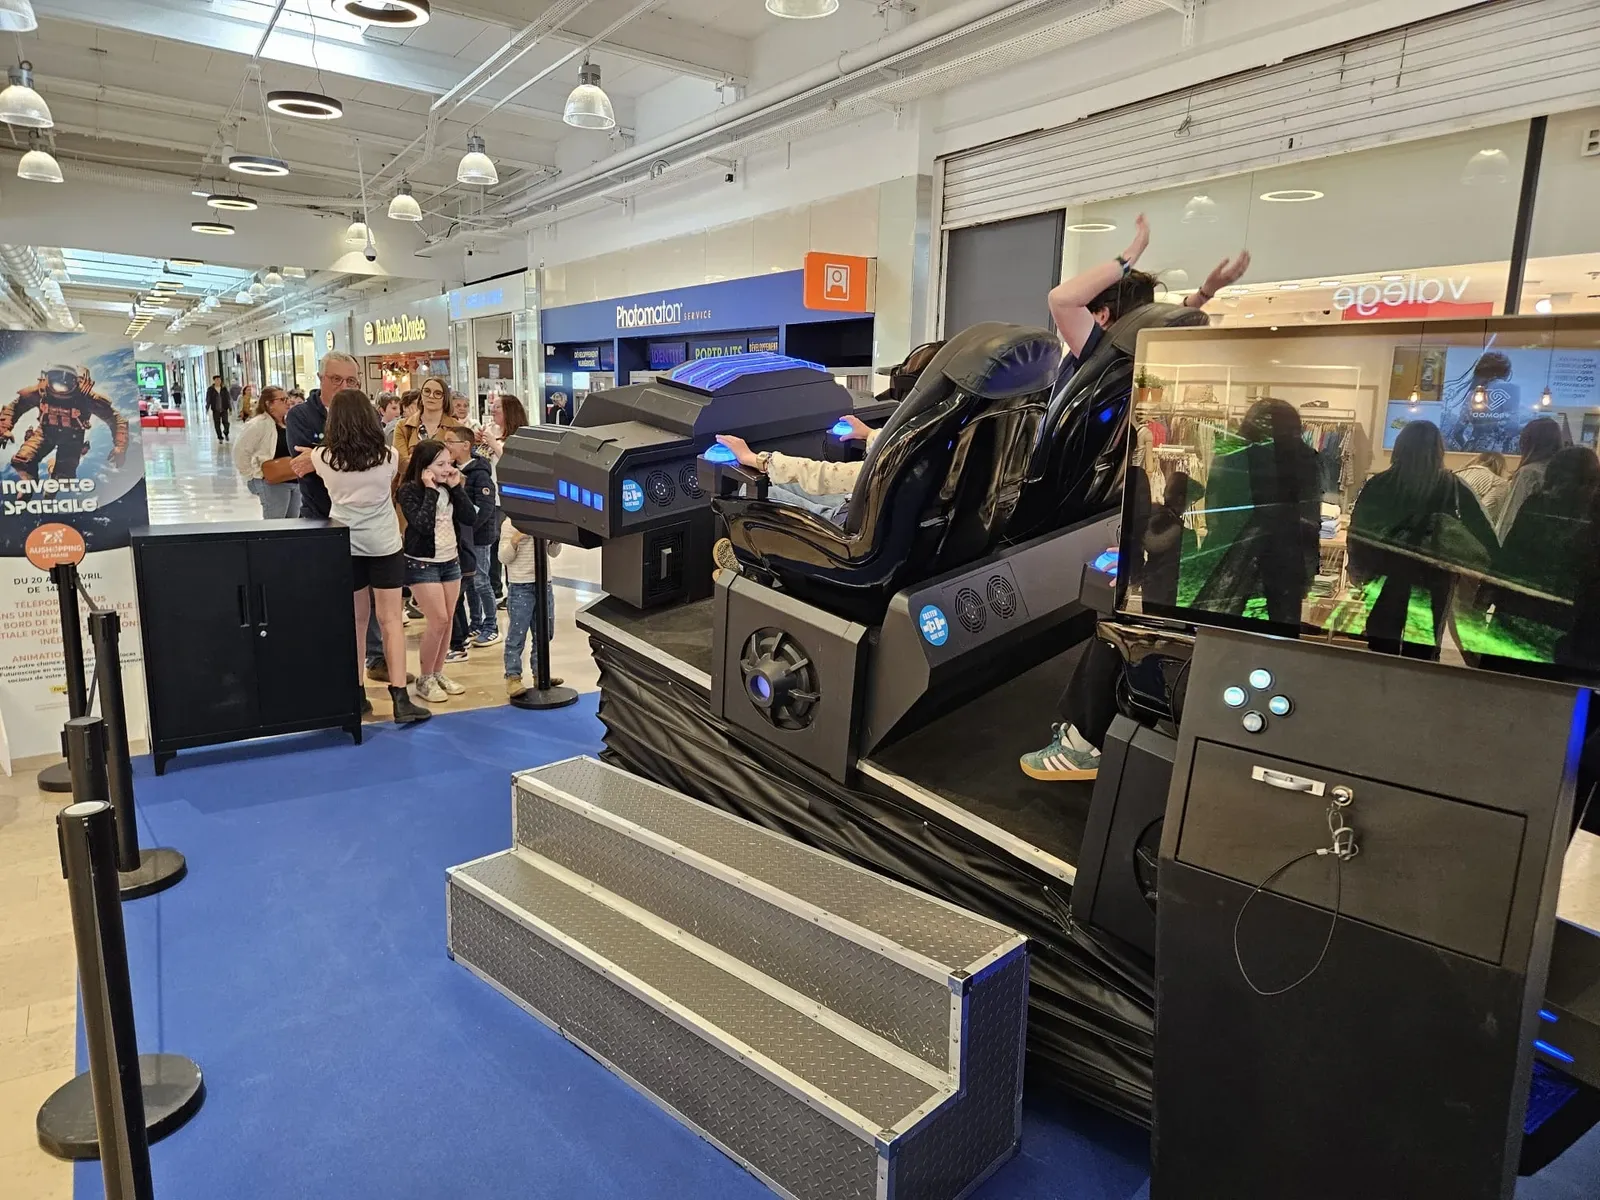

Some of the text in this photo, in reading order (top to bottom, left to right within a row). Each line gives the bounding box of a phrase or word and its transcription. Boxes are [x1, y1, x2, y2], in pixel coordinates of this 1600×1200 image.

[616, 300, 712, 328] Photomaton SERVICE
[375, 313, 426, 345] Brioche Dorée
[695, 345, 743, 360] PORTRAITS
[80, 572, 102, 580] VRIL
[3, 620, 32, 629] BORD
[12, 651, 64, 663] ANIMATIO
